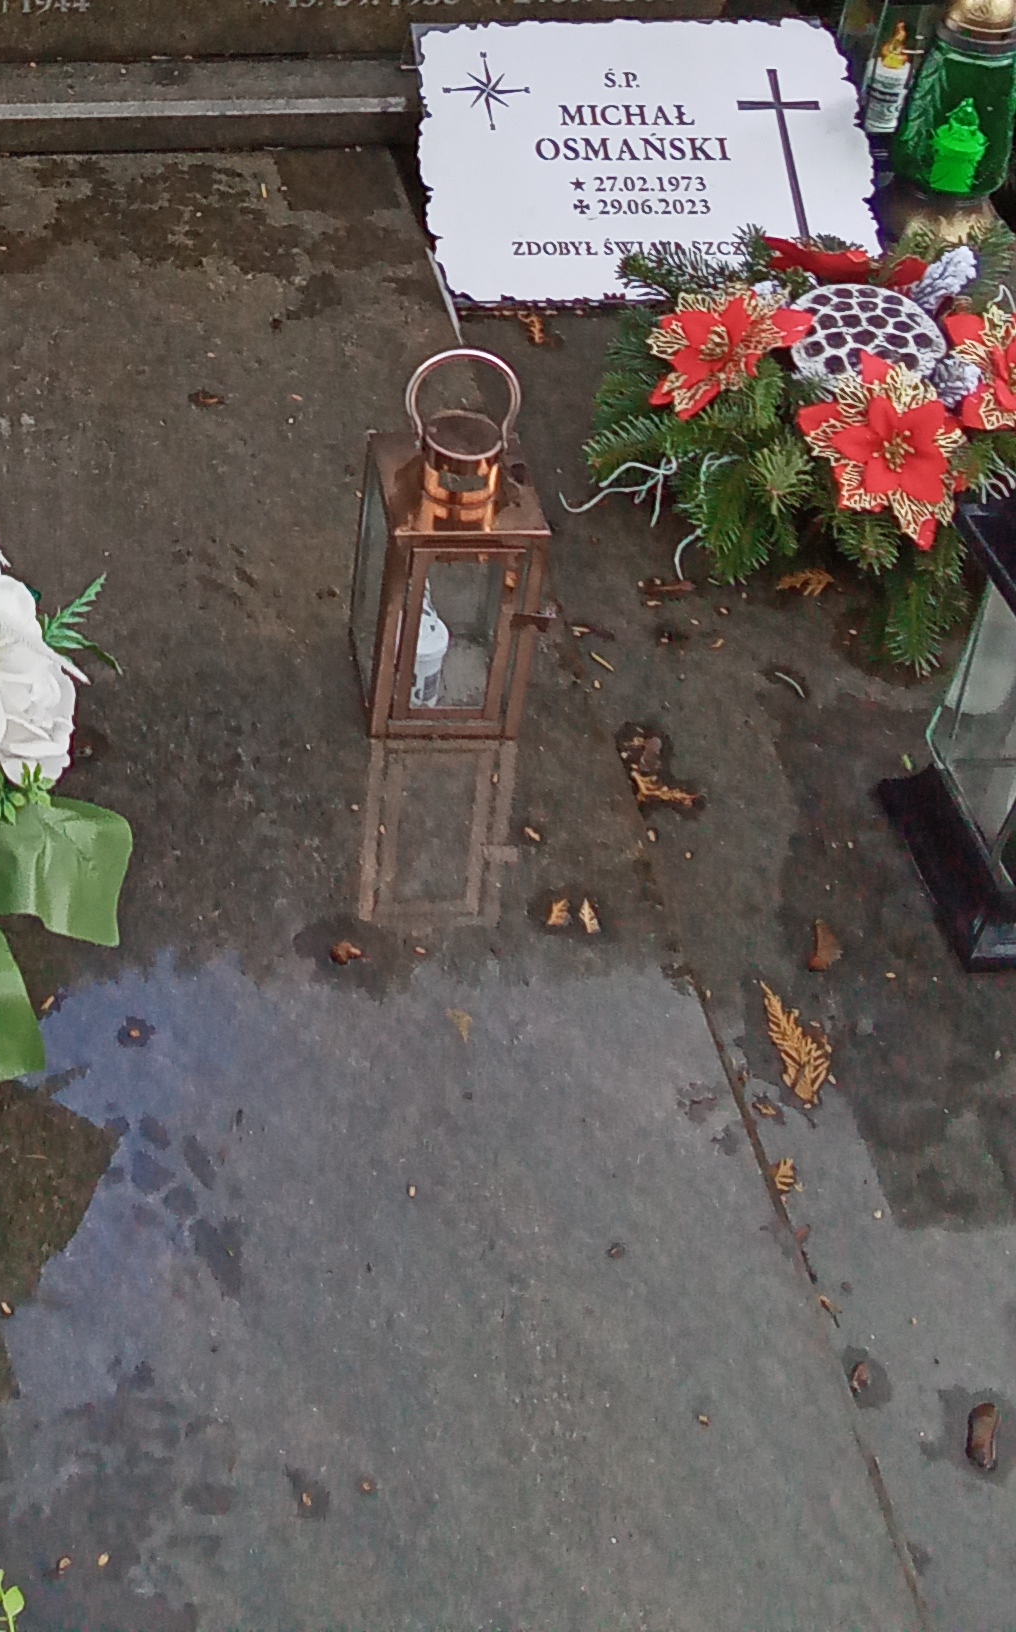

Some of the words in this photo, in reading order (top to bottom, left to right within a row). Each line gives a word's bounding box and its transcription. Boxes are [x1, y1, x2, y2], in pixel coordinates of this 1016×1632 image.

[603, 68, 642, 90] Ś.P.
[560, 104, 696, 127] MICHAŁ
[535, 132, 732, 163] OSMAŃSKI
[593, 175, 708, 193] 27.02.1973
[597, 198, 712, 217] 29.06.2023
[512, 241, 598, 256] ZDOBYŁ
